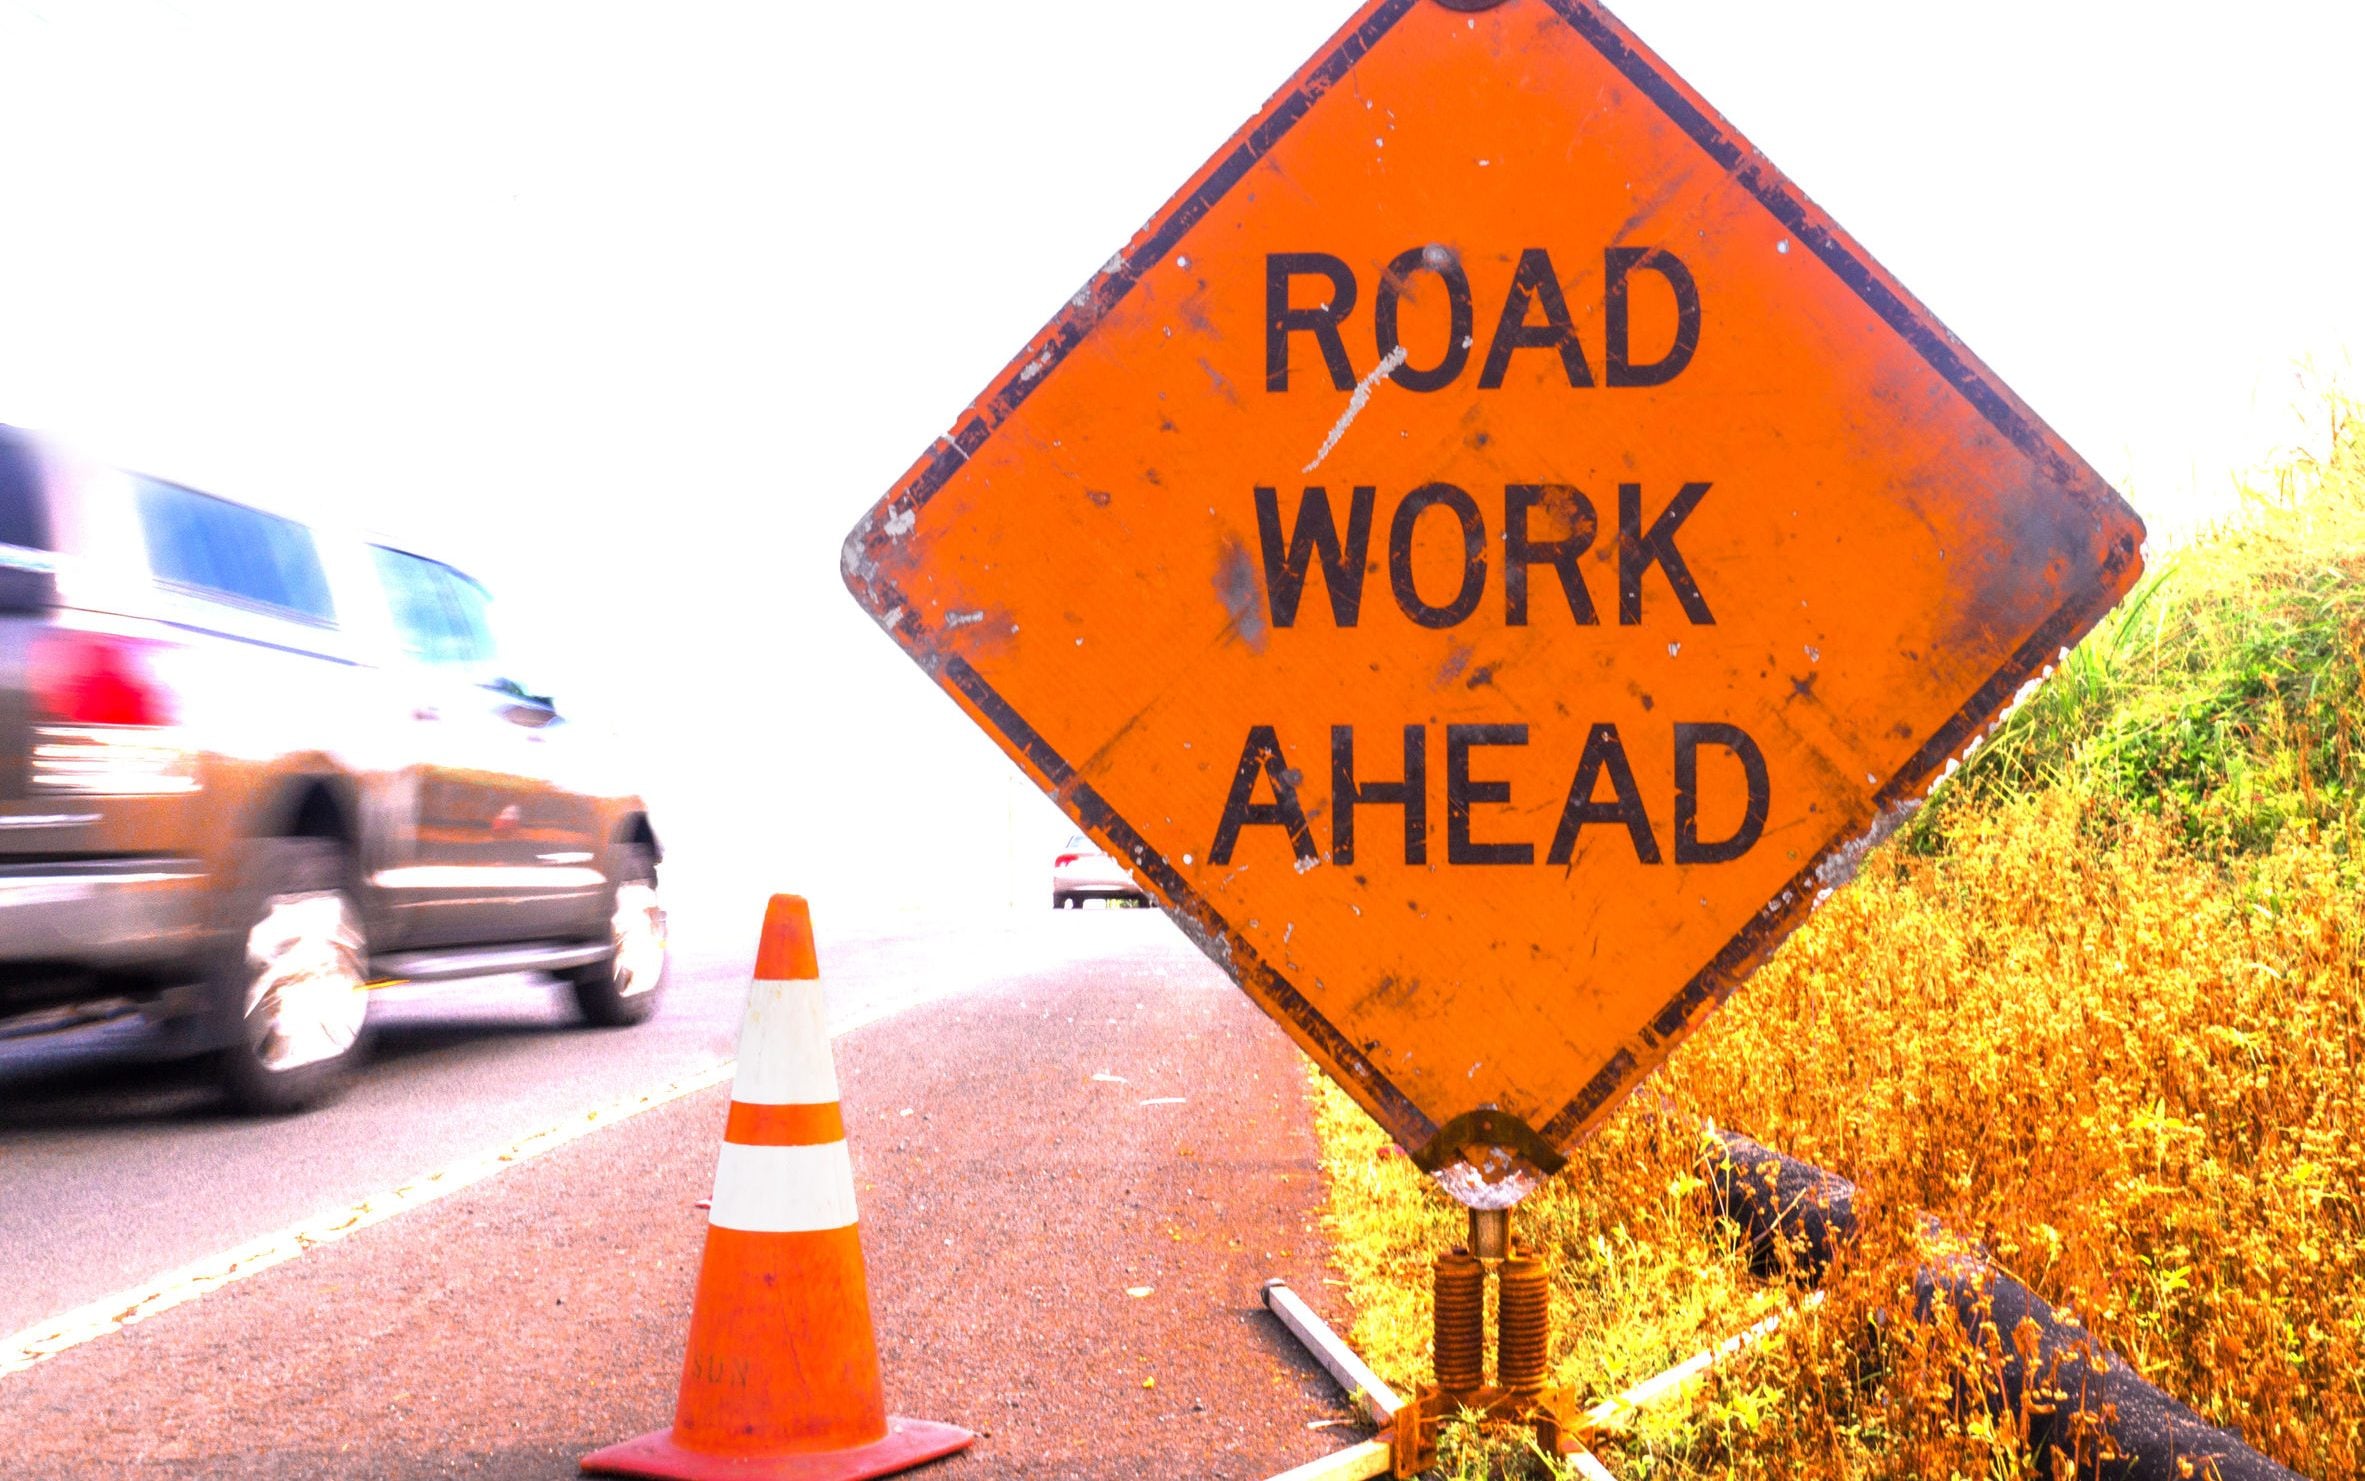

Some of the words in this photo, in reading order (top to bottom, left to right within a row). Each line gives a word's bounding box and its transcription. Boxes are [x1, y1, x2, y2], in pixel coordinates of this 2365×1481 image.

[1265, 246, 1702, 393] ROAD
[1252, 481, 1717, 630] WORK
[1207, 721, 1771, 867] AHEAD
